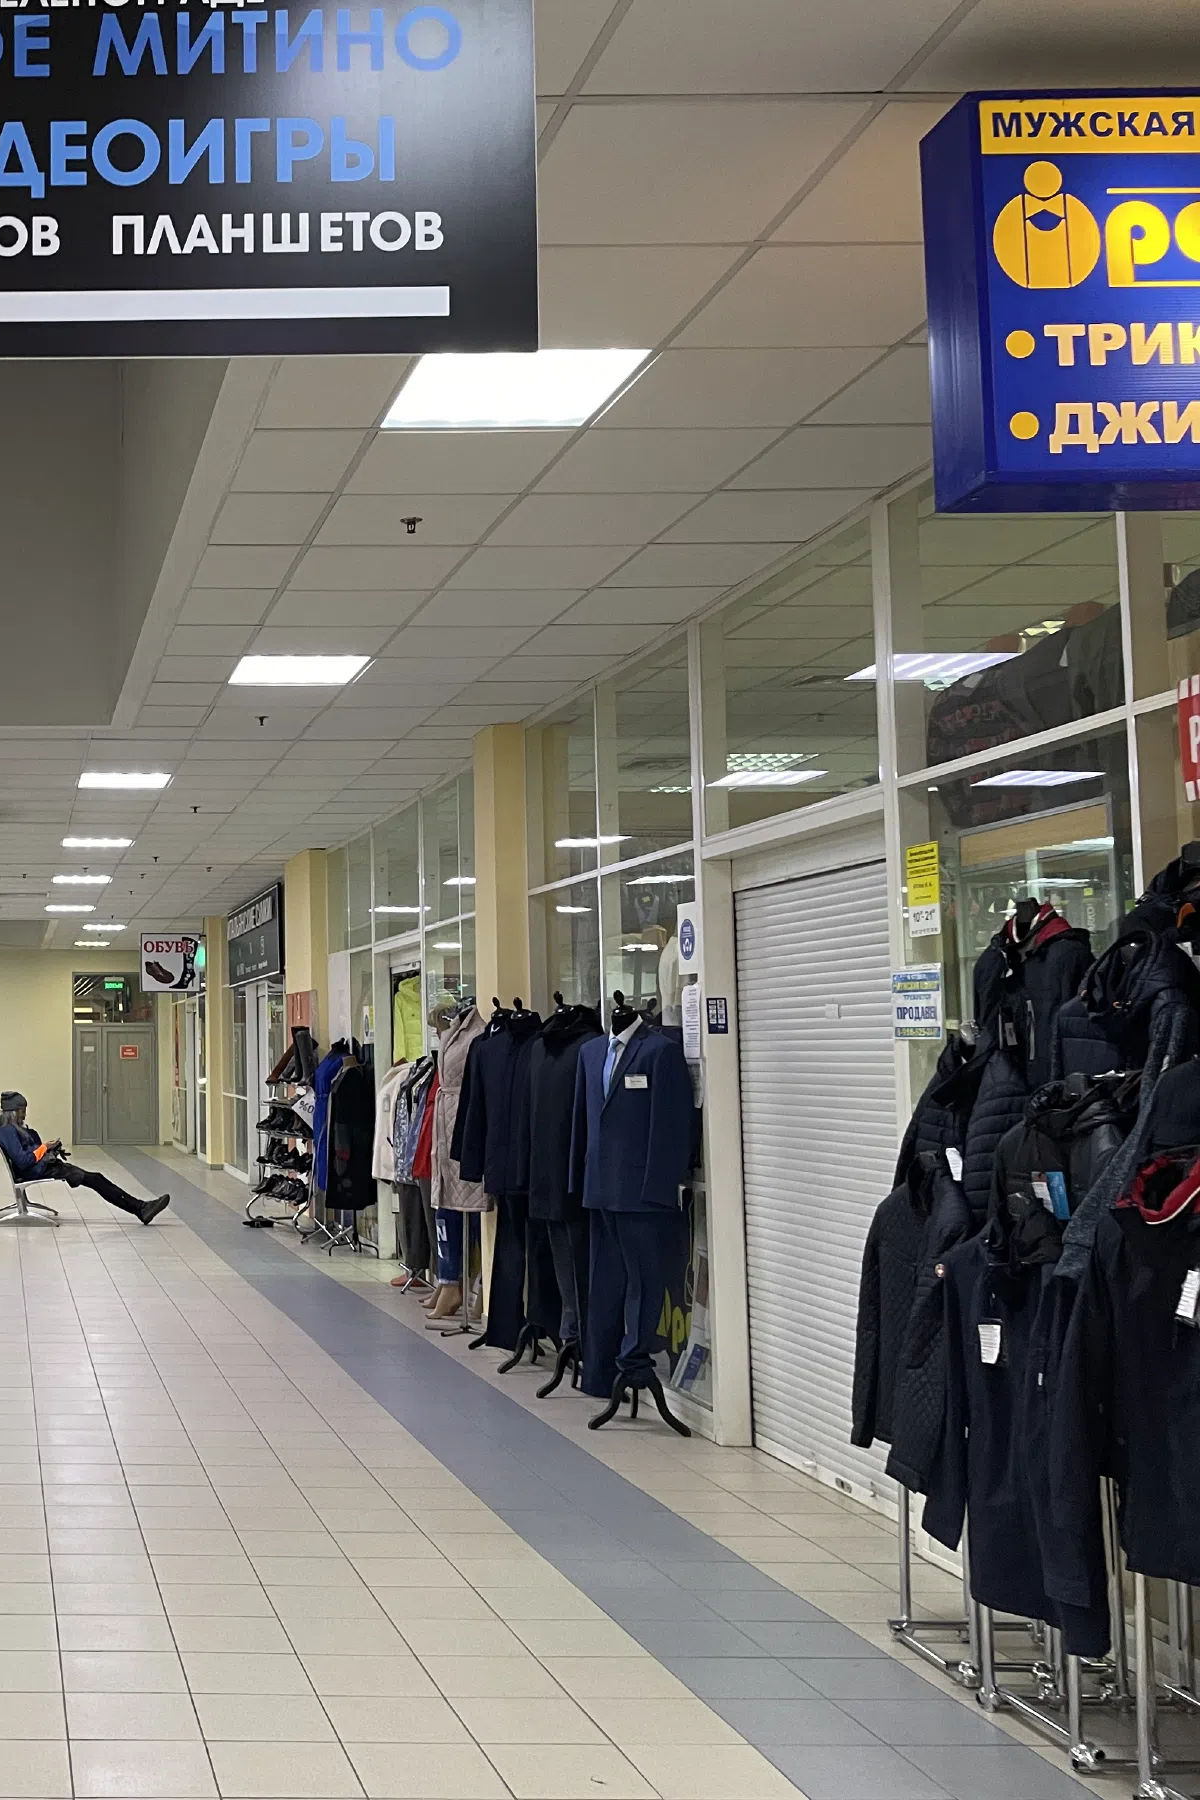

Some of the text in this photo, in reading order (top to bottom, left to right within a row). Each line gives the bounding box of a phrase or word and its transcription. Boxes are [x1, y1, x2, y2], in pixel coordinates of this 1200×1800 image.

[93, 7, 462, 77] МИТИНО
[992, 111, 1195, 138] МУЖСКАЯ
[112, 211, 444, 255] ПЛАНШЕТОВ
[143, 940, 195, 953] ОБУВЬ
